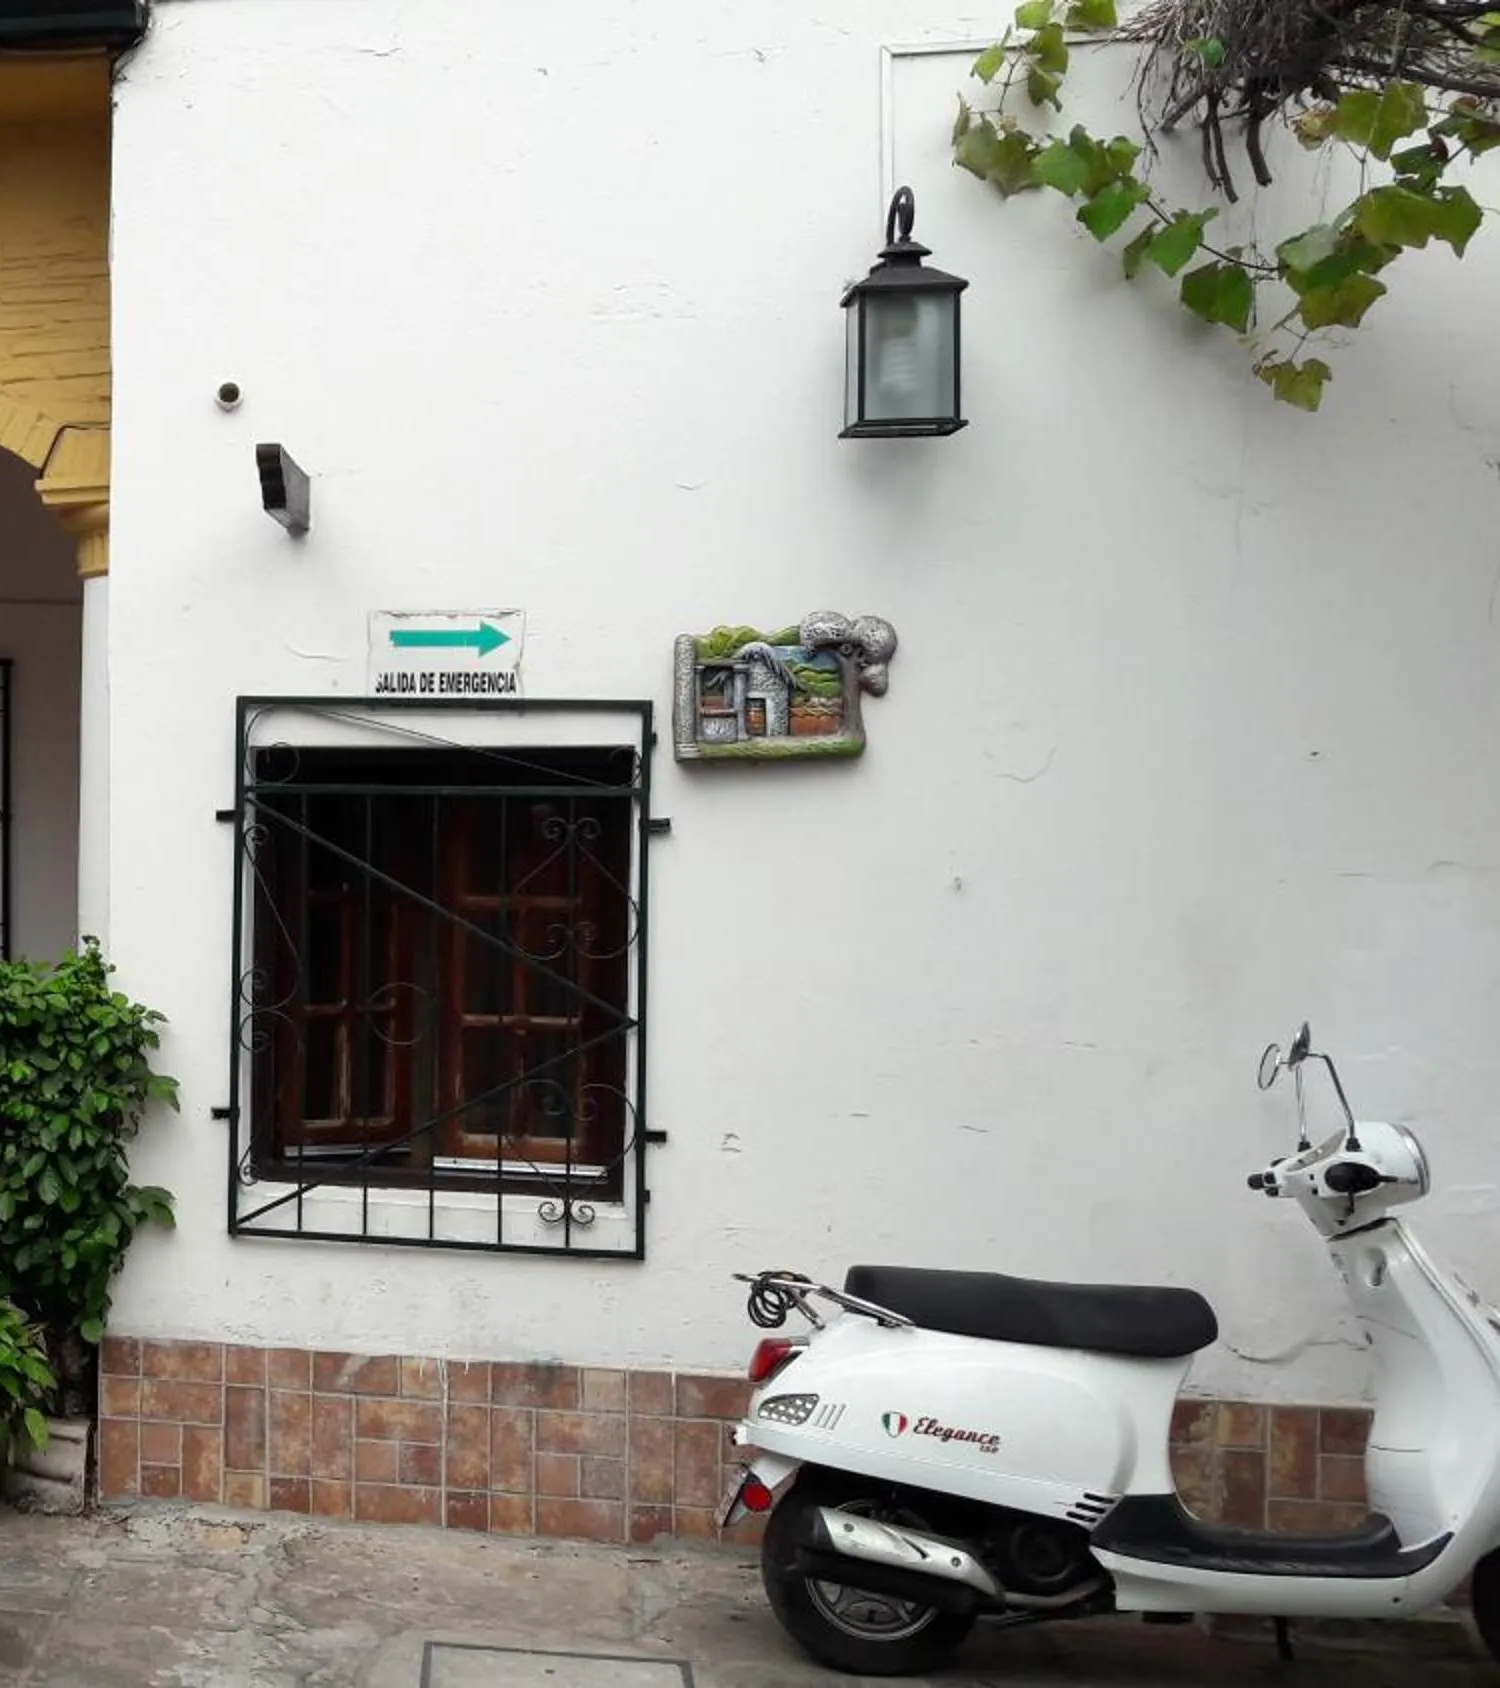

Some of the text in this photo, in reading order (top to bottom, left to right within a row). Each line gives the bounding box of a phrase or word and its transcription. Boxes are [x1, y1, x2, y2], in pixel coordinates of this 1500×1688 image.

[375, 671, 516, 693] SALIDA DE EMERGENCIA
[913, 1416, 1001, 1445] Elegance
